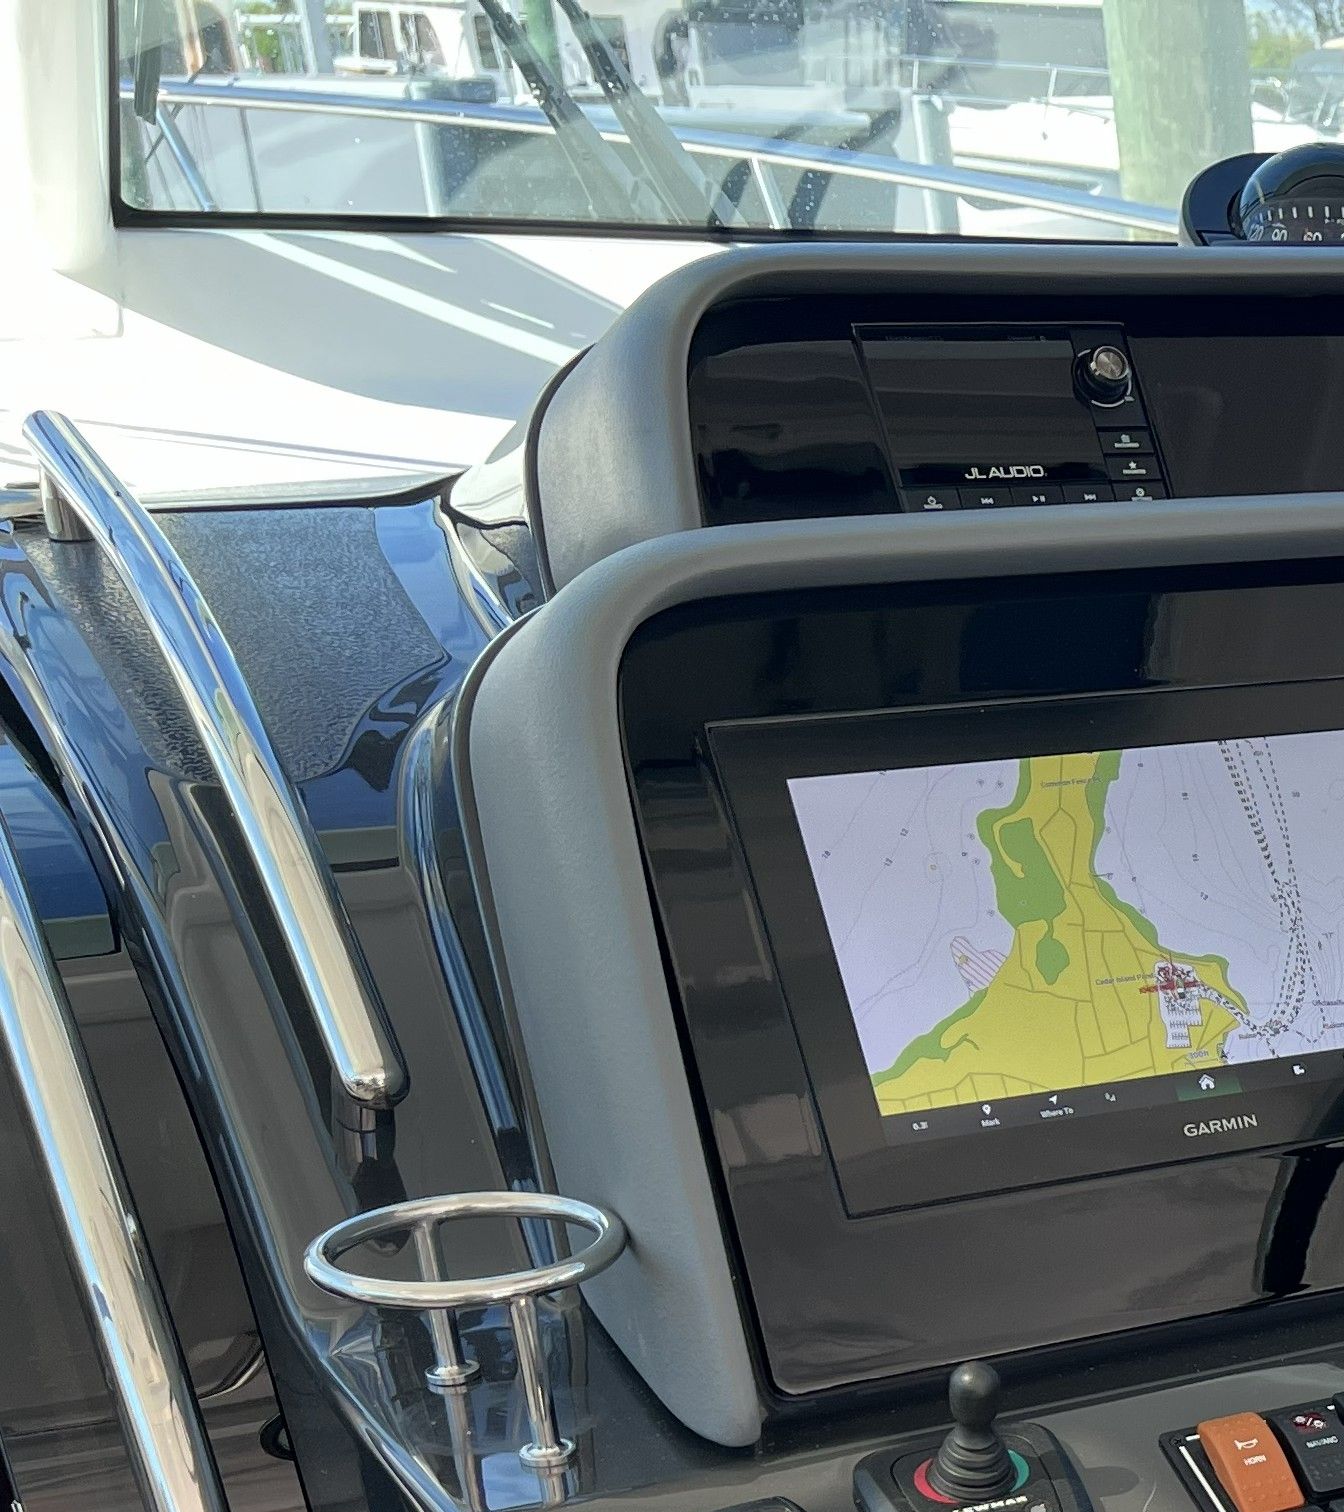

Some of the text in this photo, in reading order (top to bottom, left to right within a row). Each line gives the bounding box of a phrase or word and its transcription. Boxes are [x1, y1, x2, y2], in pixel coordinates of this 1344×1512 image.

[965, 466, 1044, 480] JL AUDIO
[1183, 1113, 1259, 1138] GARMIN
[1243, 1454, 1267, 1466] HORN
